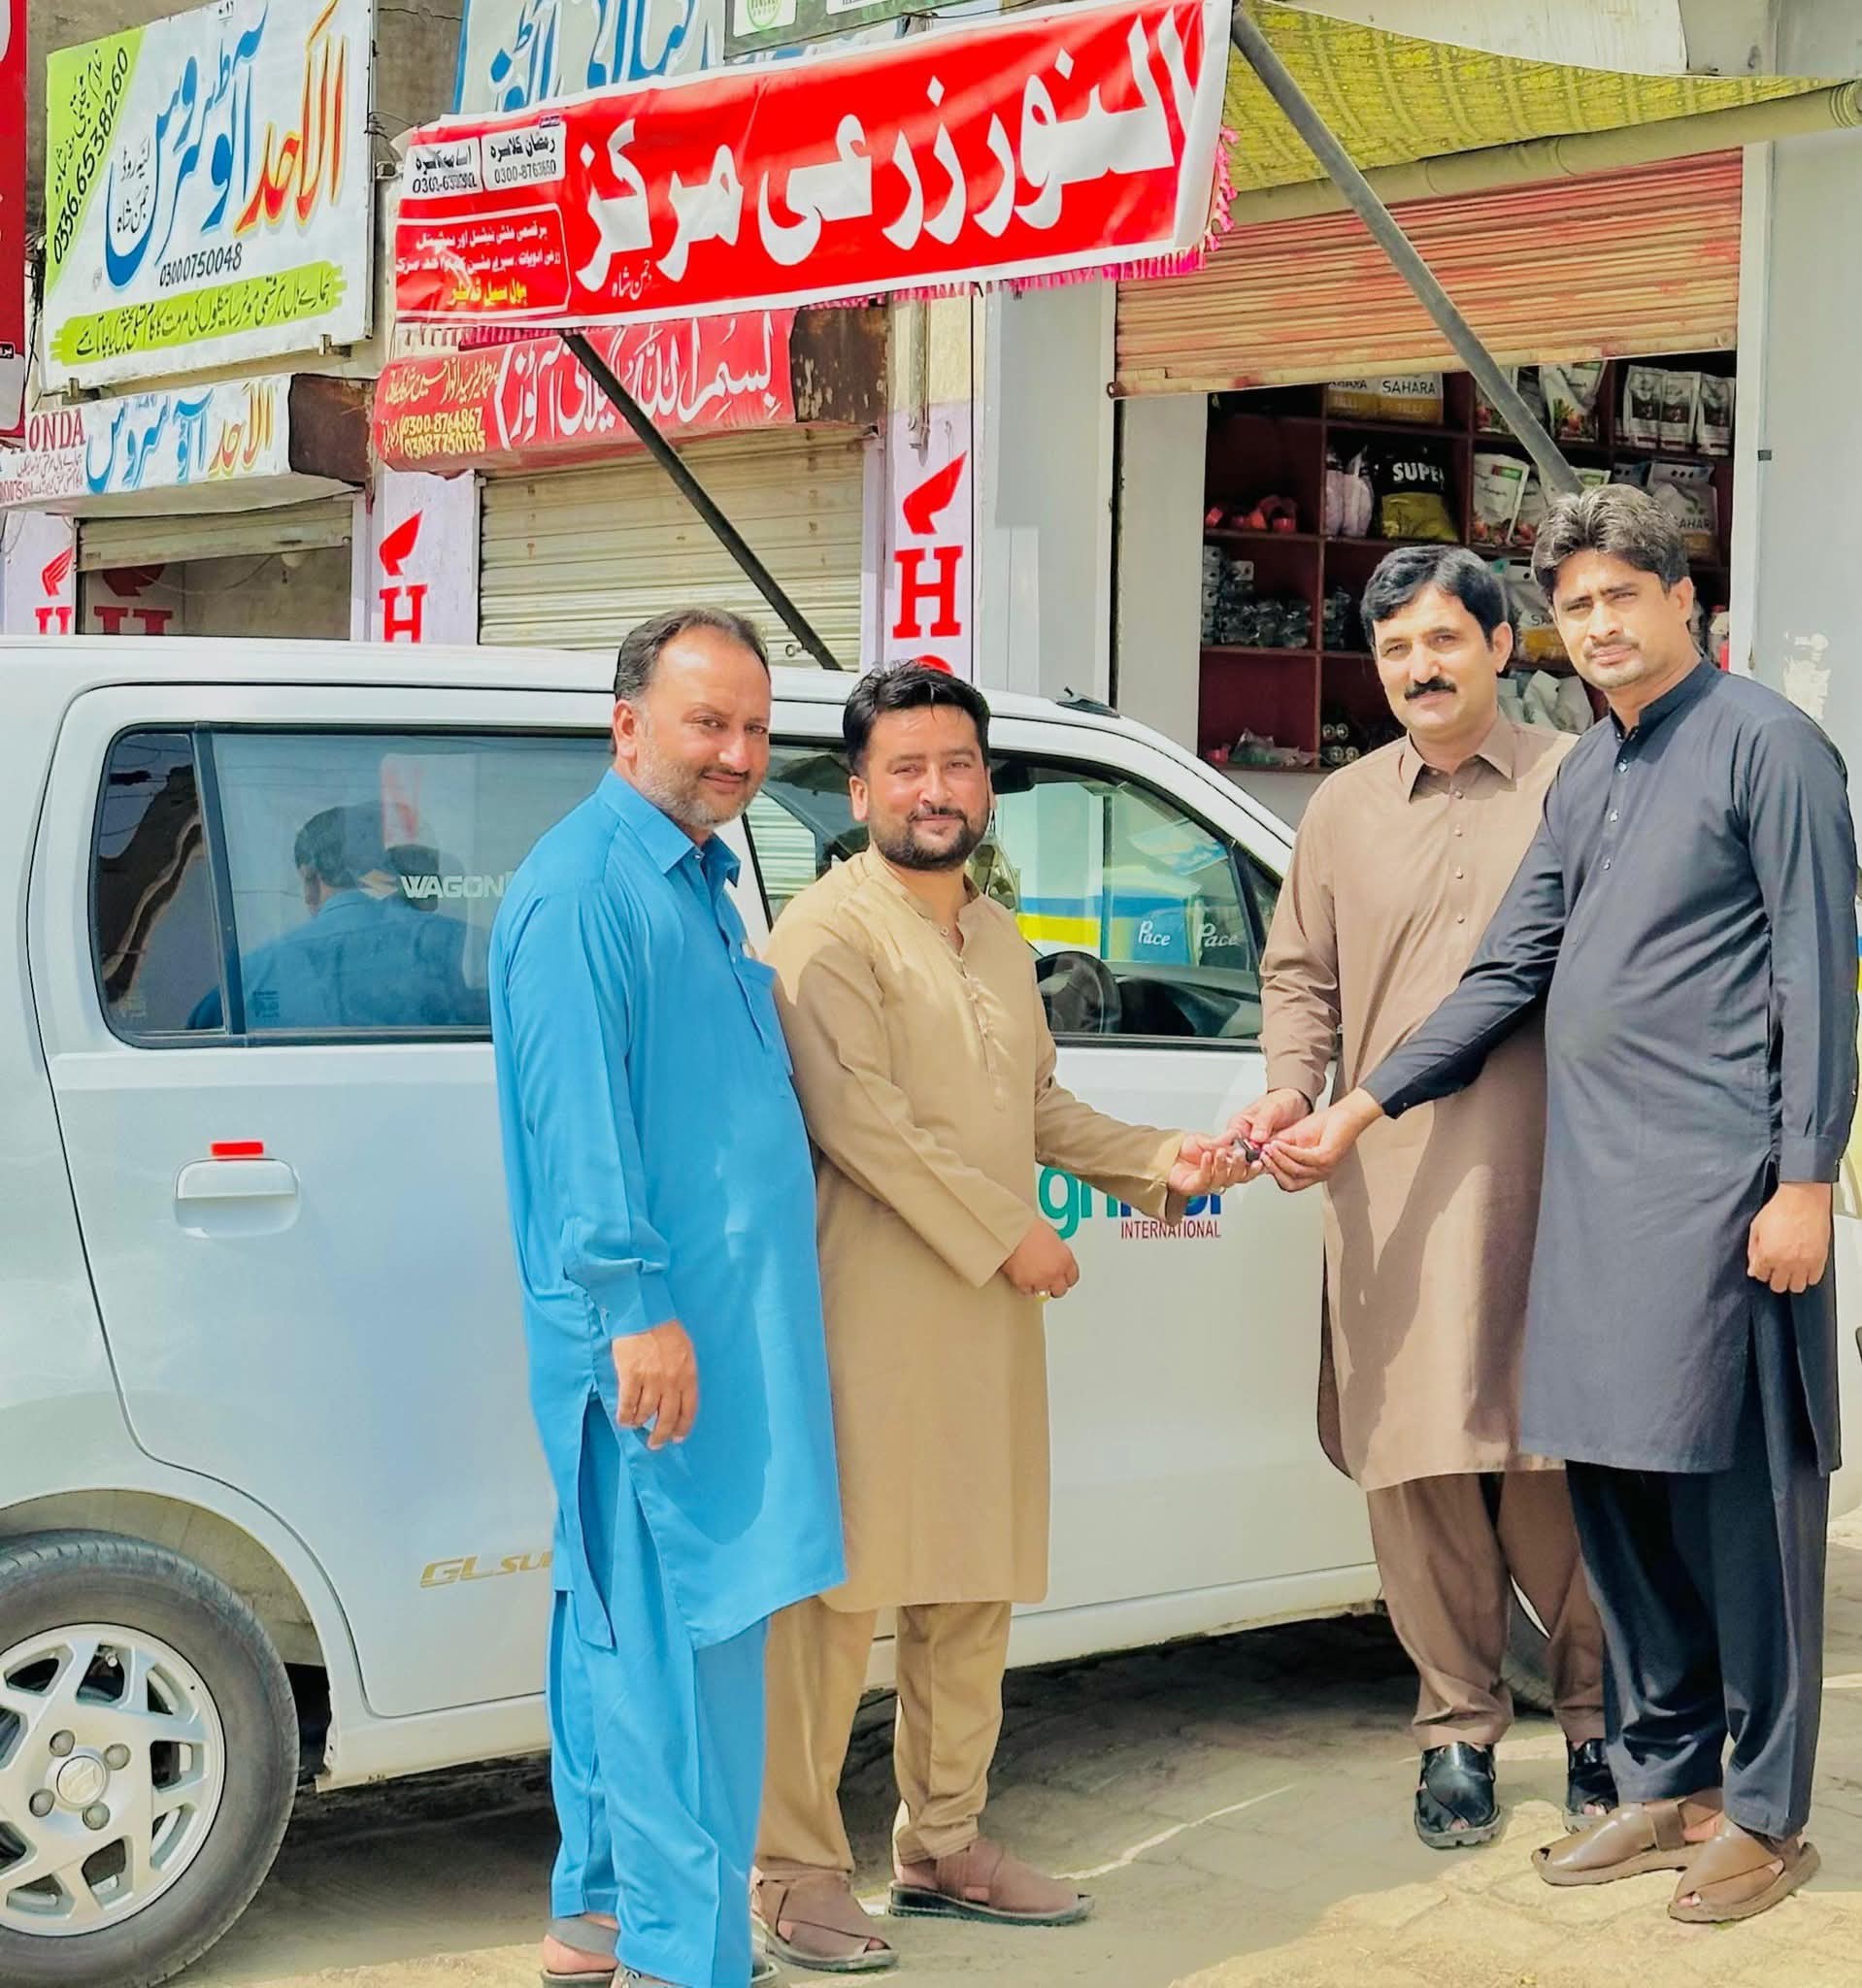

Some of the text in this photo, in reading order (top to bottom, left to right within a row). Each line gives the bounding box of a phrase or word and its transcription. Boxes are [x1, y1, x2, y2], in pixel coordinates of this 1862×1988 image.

[575, 7, 1195, 291] النور زرعی مرکز
[159, 242, 243, 287] 03000750048
[1381, 380, 1437, 395] SAHARA
[1120, 1219, 1222, 1240] INTERNATIONAL
